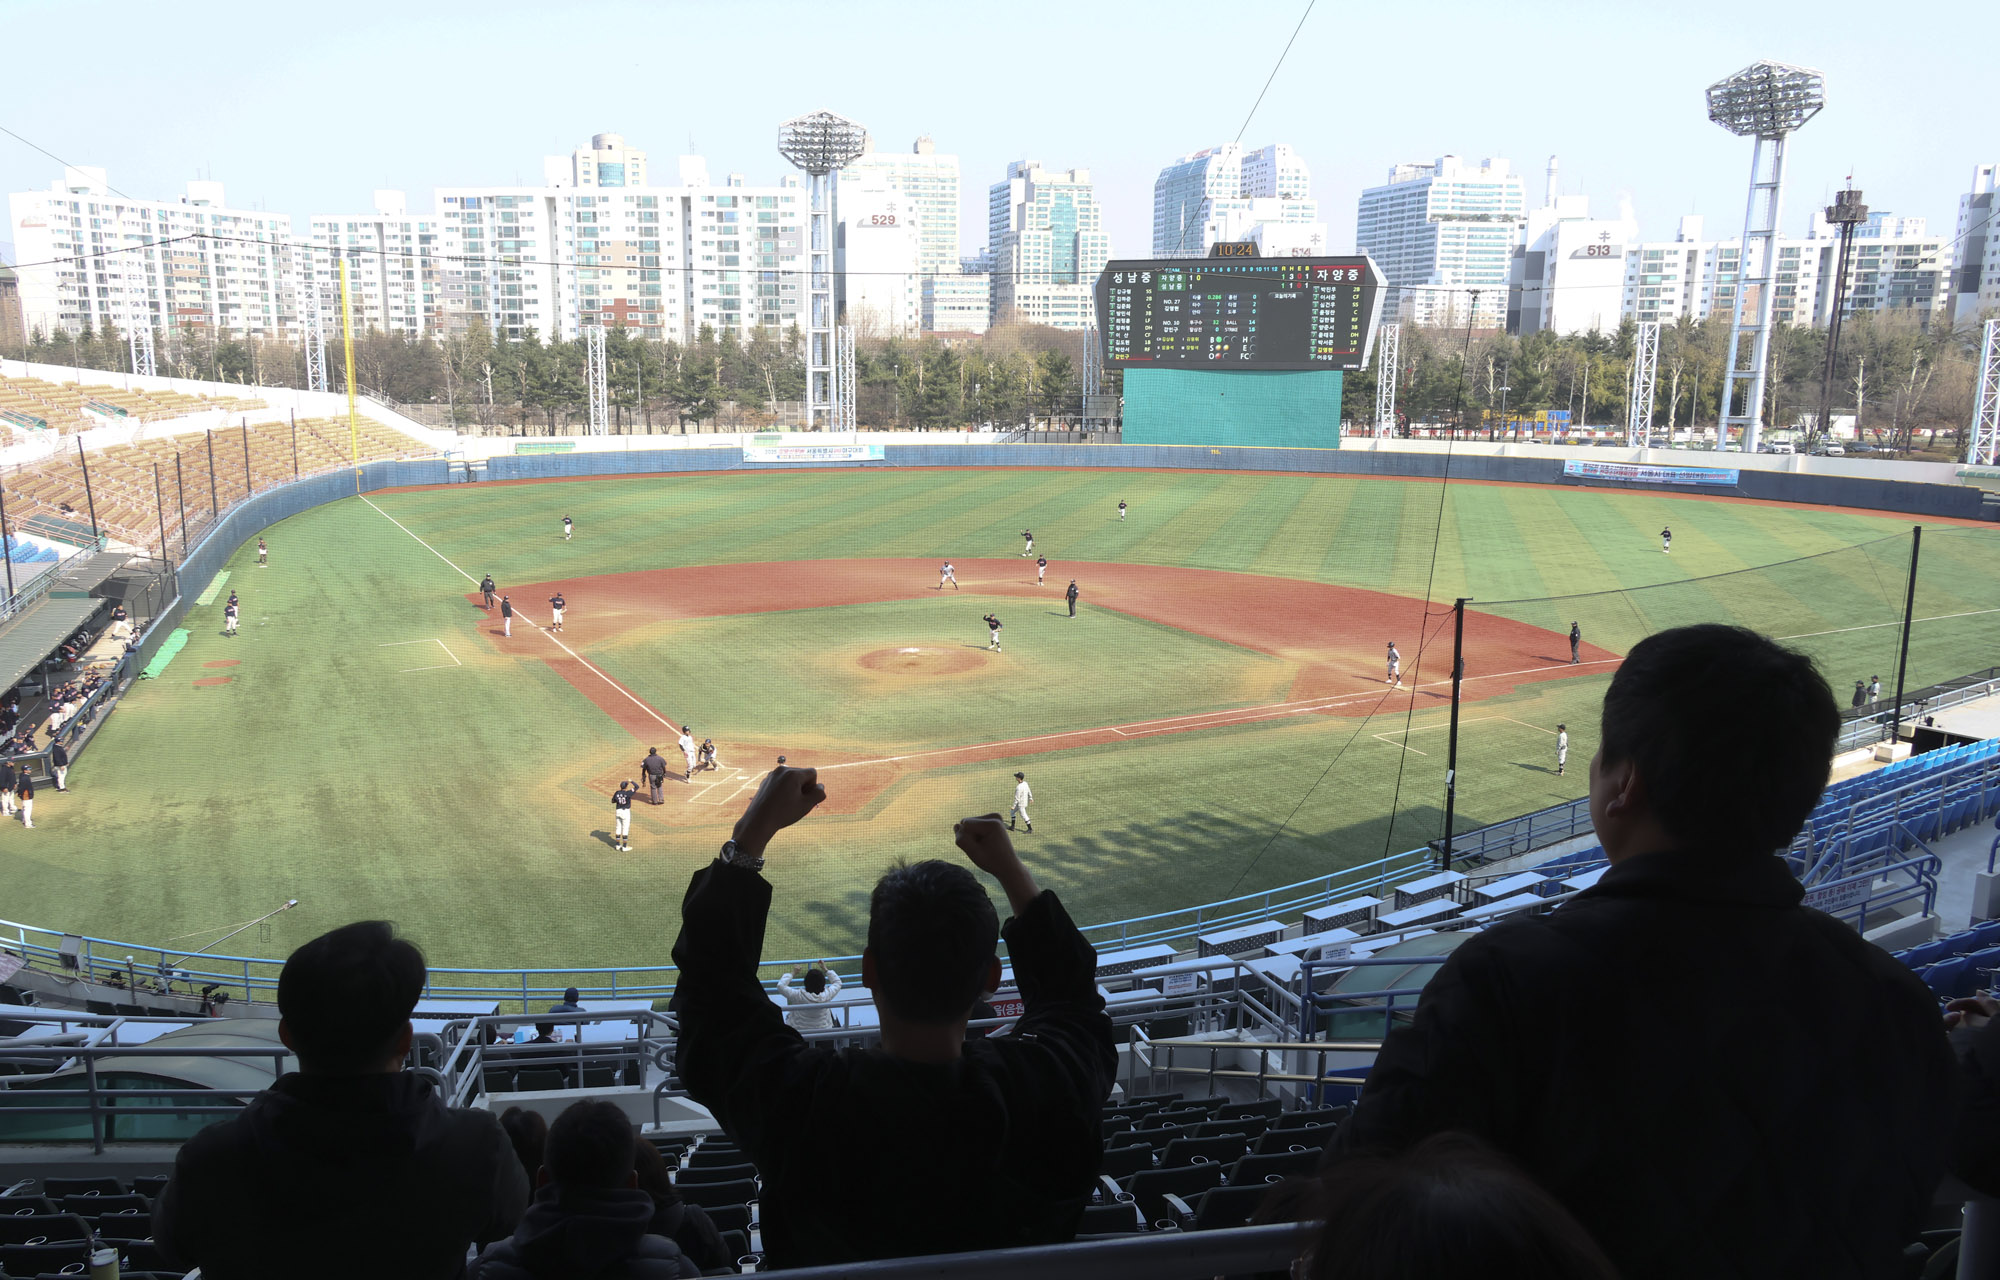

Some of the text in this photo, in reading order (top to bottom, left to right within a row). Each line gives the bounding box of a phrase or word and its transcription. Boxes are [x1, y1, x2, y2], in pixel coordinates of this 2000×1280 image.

[872, 215, 895, 225] 529
[1588, 245, 1610, 256] 513
[1317, 269, 1359, 281] 자양중
